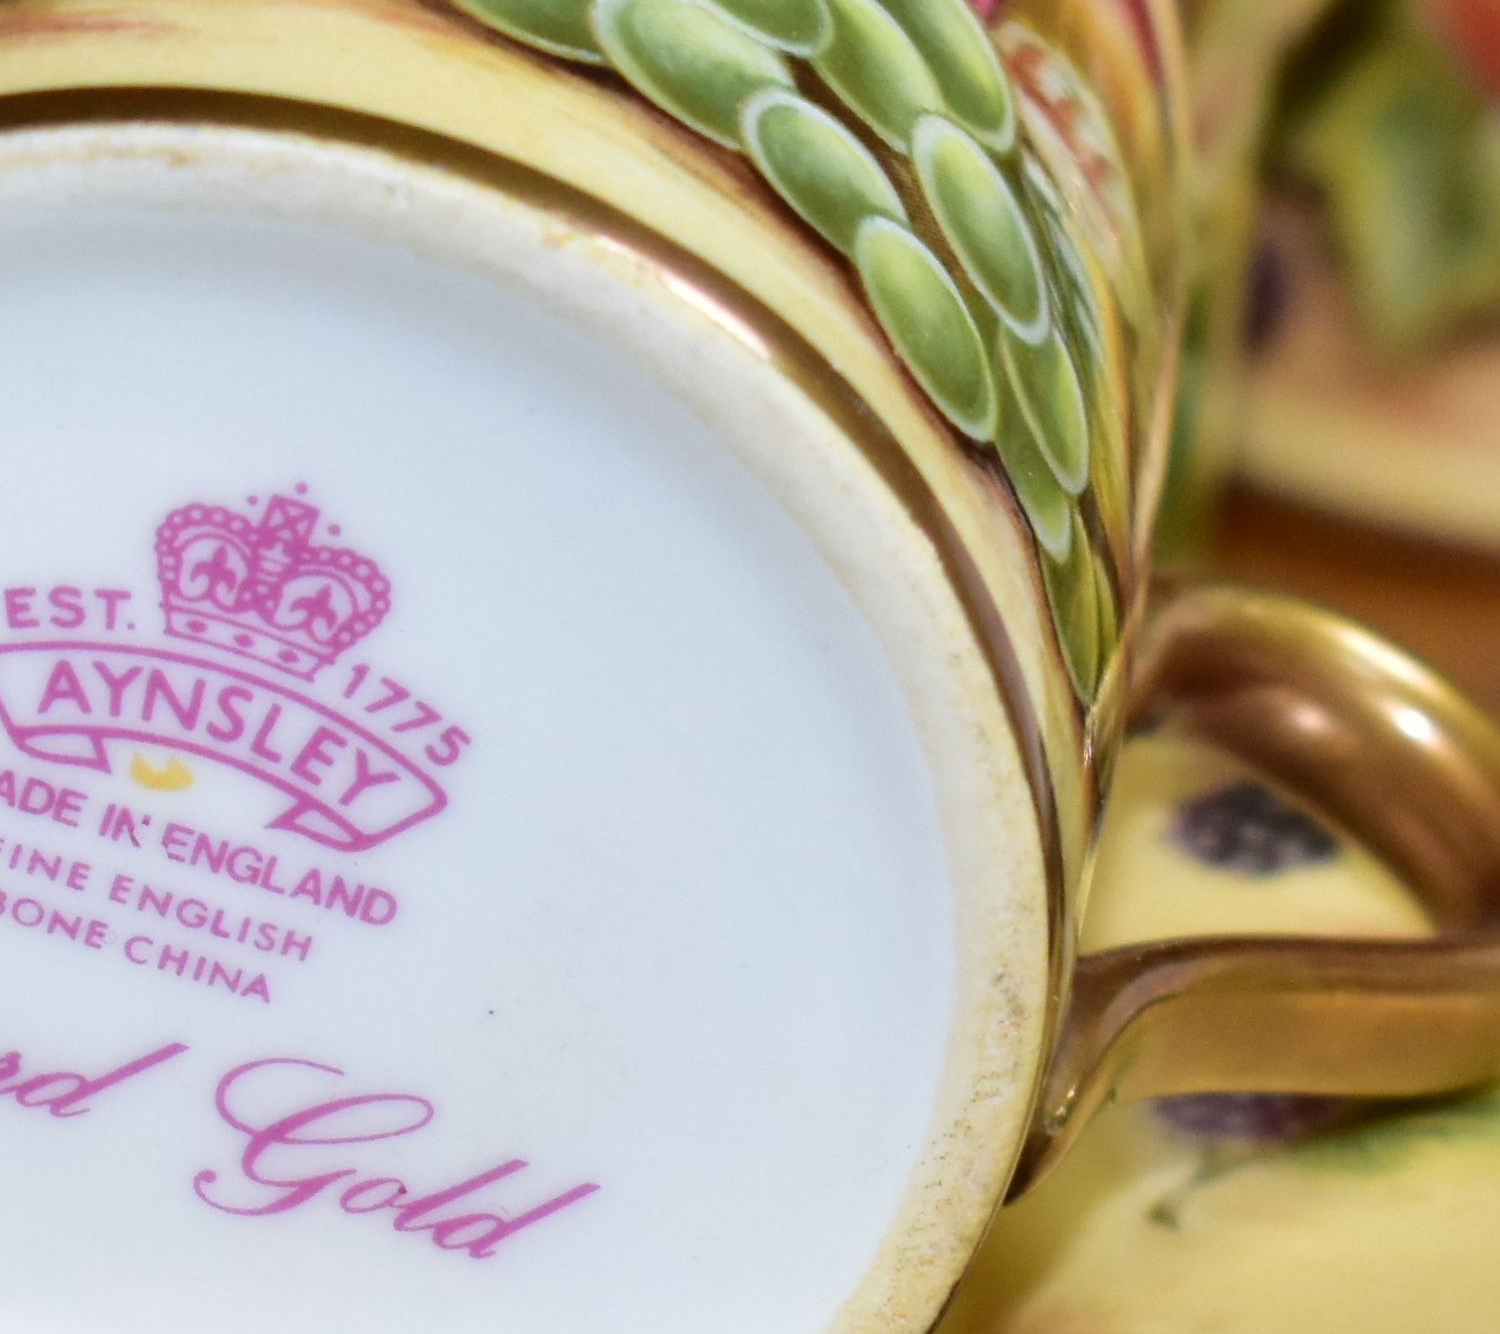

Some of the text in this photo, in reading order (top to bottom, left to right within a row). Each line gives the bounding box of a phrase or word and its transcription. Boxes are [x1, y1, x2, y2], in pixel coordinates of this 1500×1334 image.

[3, 584, 473, 768] EST. 1775
[38, 657, 402, 809] AYNSLEY
[98, 803, 153, 849] IN
[161, 822, 399, 927] ENGLAND
[109, 874, 313, 962] ENGLISH
[124, 935, 271, 1003] CHINA
[193, 1056, 601, 1260] Gold
